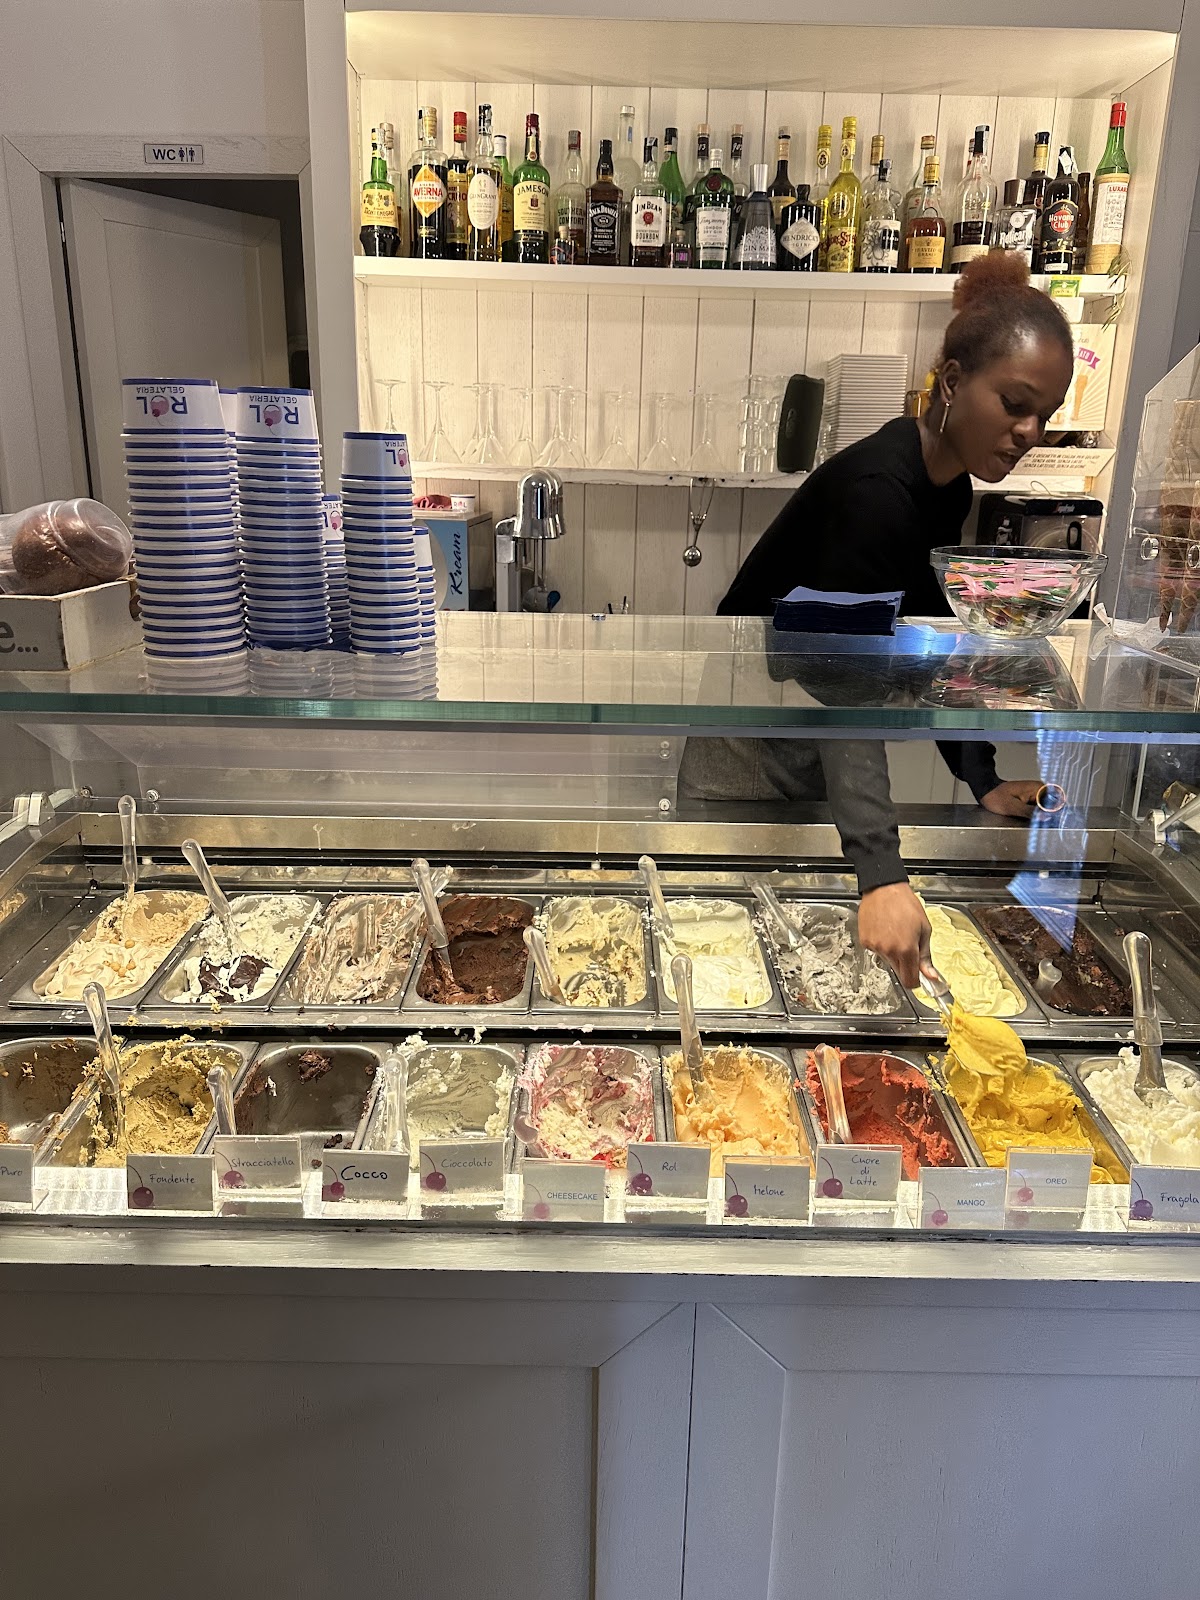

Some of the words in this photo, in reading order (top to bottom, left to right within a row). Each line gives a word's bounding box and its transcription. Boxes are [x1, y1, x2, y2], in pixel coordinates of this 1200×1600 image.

[152, 148, 176, 161] WC
[413, 187, 444, 198] AVERNA
[516, 184, 549, 197] JAMESON
[1048, 213, 1075, 223] Havana
[1053, 221, 1069, 229] Club
[136, 386, 185, 394] GELATERIA
[249, 395, 298, 404] GELATERIA
[230, 1158, 294, 1168] Stracciatella
[441, 1158, 493, 1168] Cioccolato
[851, 1154, 880, 1166] Cuore
[1, 1166, 23, 1176] Puro
[340, 1165, 388, 1181] Cocco
[860, 1167, 870, 1176] di
[150, 1174, 195, 1184] Fondente
[849, 1175, 878, 1187] Latte
[546, 1191, 598, 1201] CHEESECAKE
[1160, 1193, 1199, 1208] Fragola
[956, 1199, 986, 1207] MANGO
